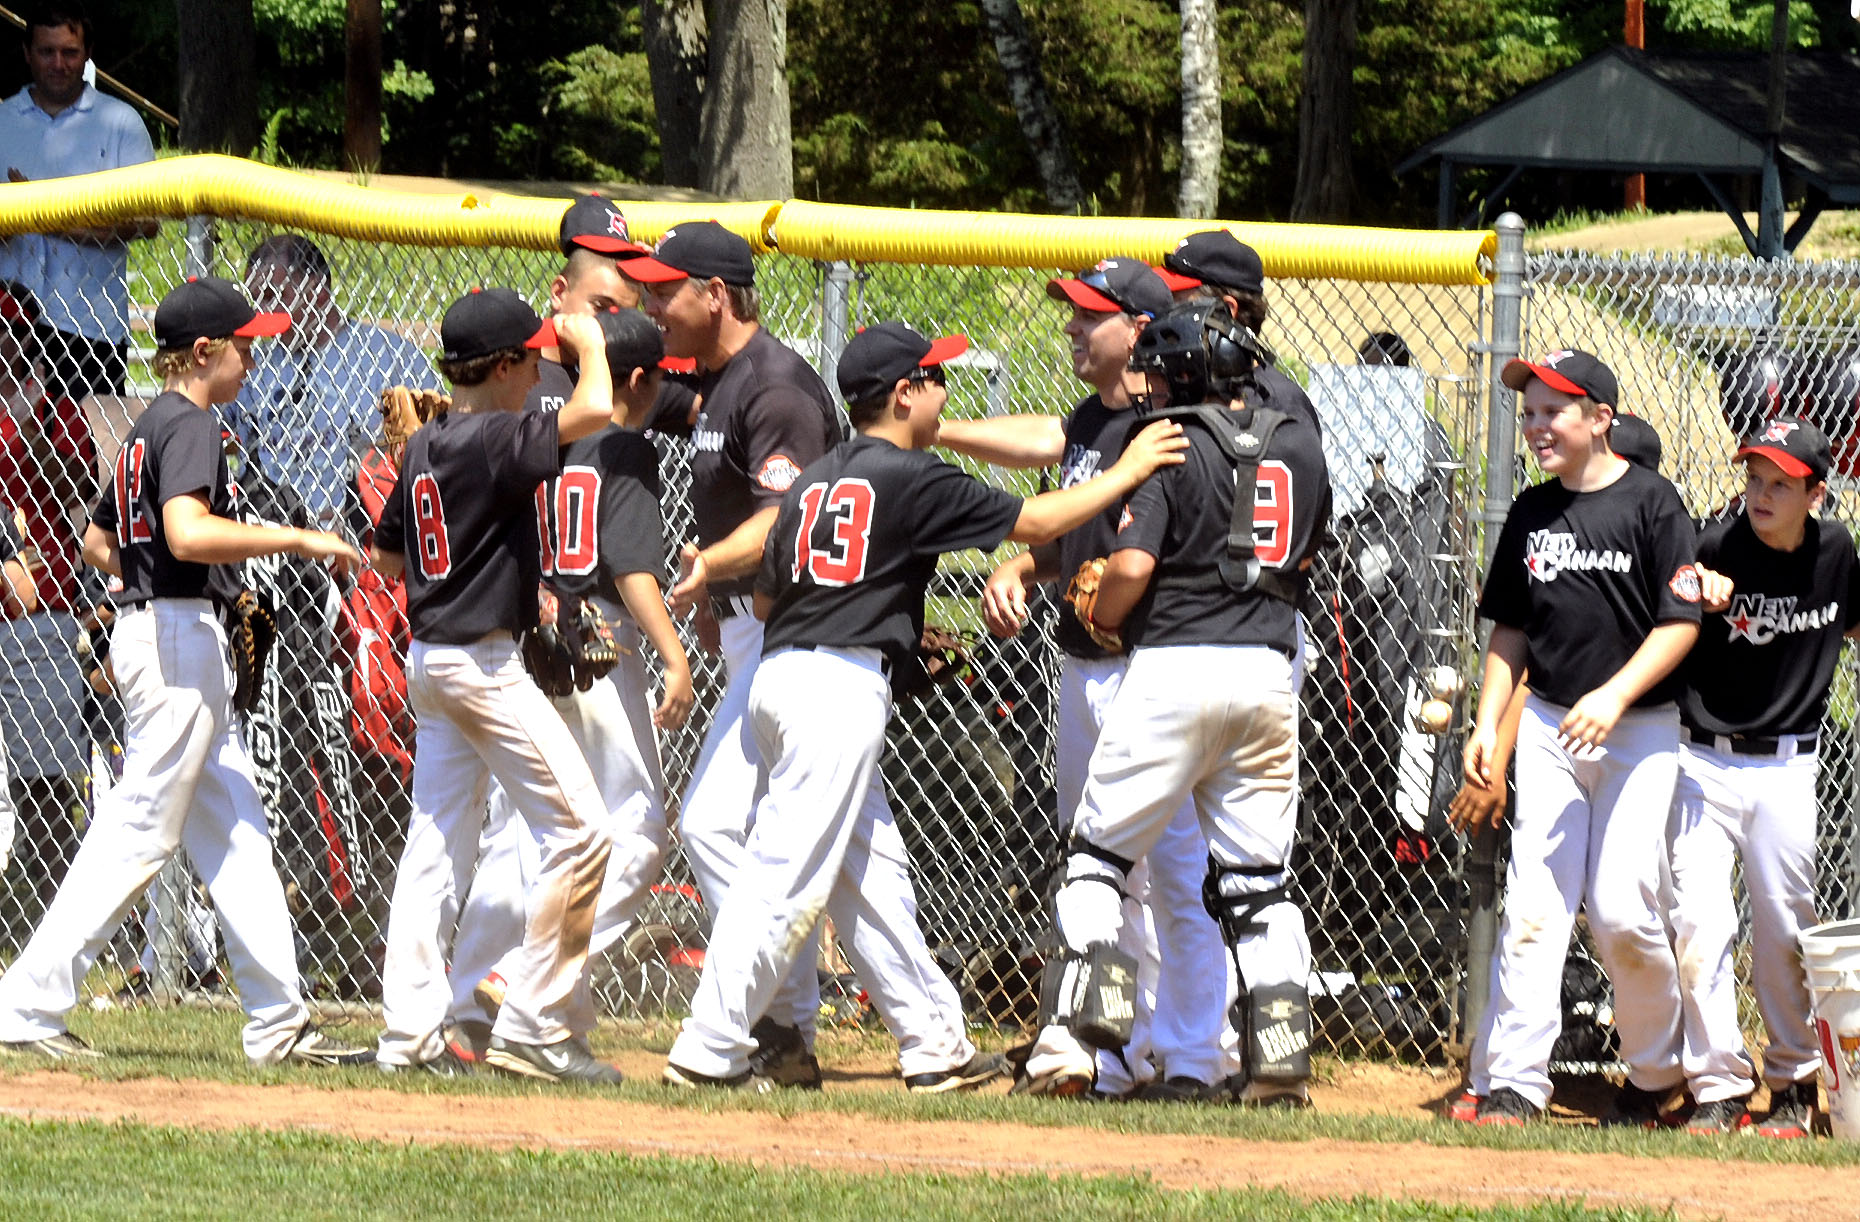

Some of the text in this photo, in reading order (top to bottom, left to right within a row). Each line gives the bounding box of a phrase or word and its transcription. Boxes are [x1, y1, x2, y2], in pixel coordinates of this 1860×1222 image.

[114, 438, 152, 548] 12
[411, 472, 452, 582] 8
[534, 465, 602, 577] 10
[791, 477, 876, 588] 13
